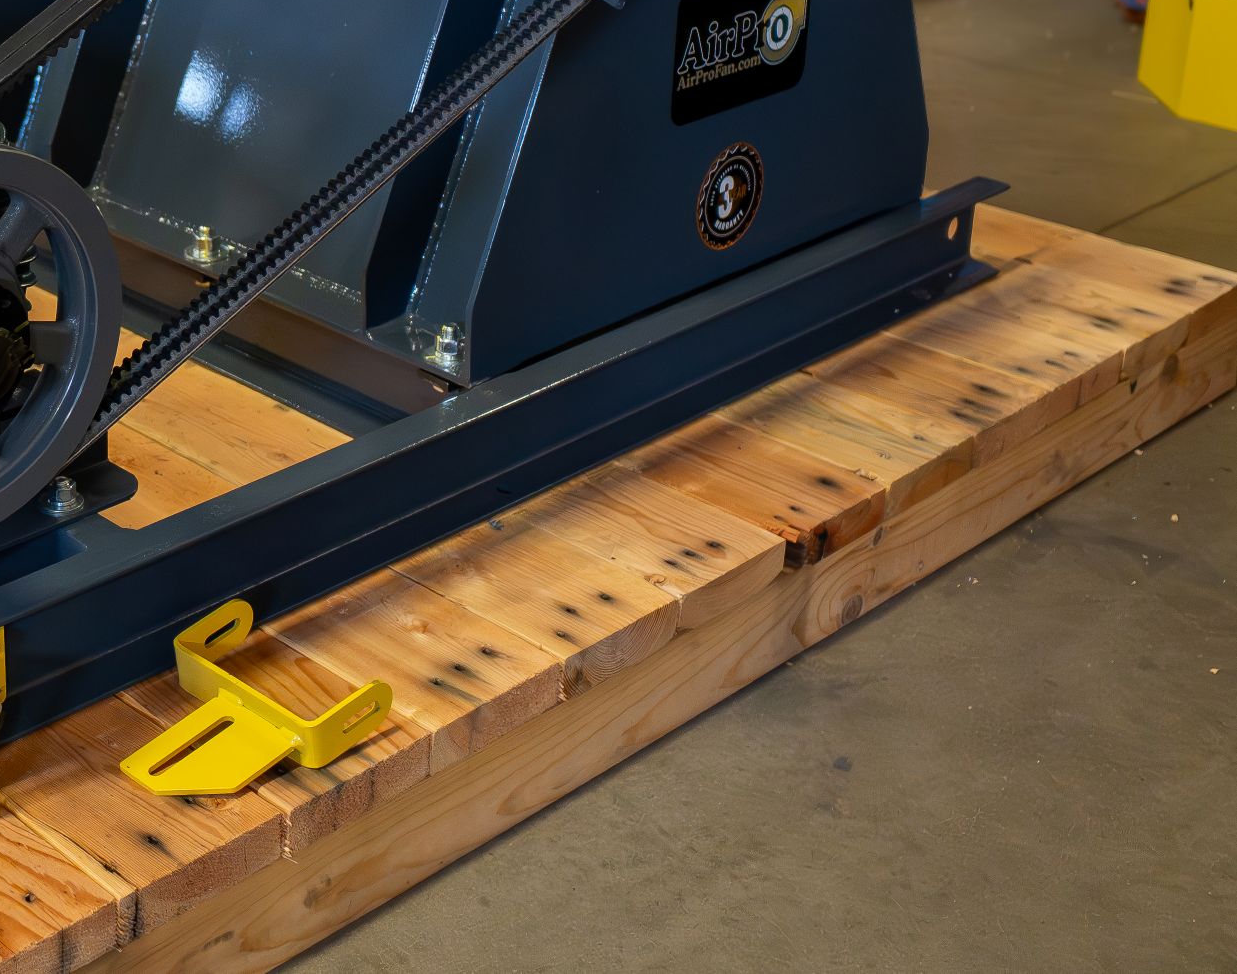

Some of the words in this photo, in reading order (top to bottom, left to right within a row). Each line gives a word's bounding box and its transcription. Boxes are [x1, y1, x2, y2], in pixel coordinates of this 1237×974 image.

[677, 8, 792, 75] AirPro
[676, 55, 762, 92] AirProFan.com
[718, 175, 735, 219] 3
